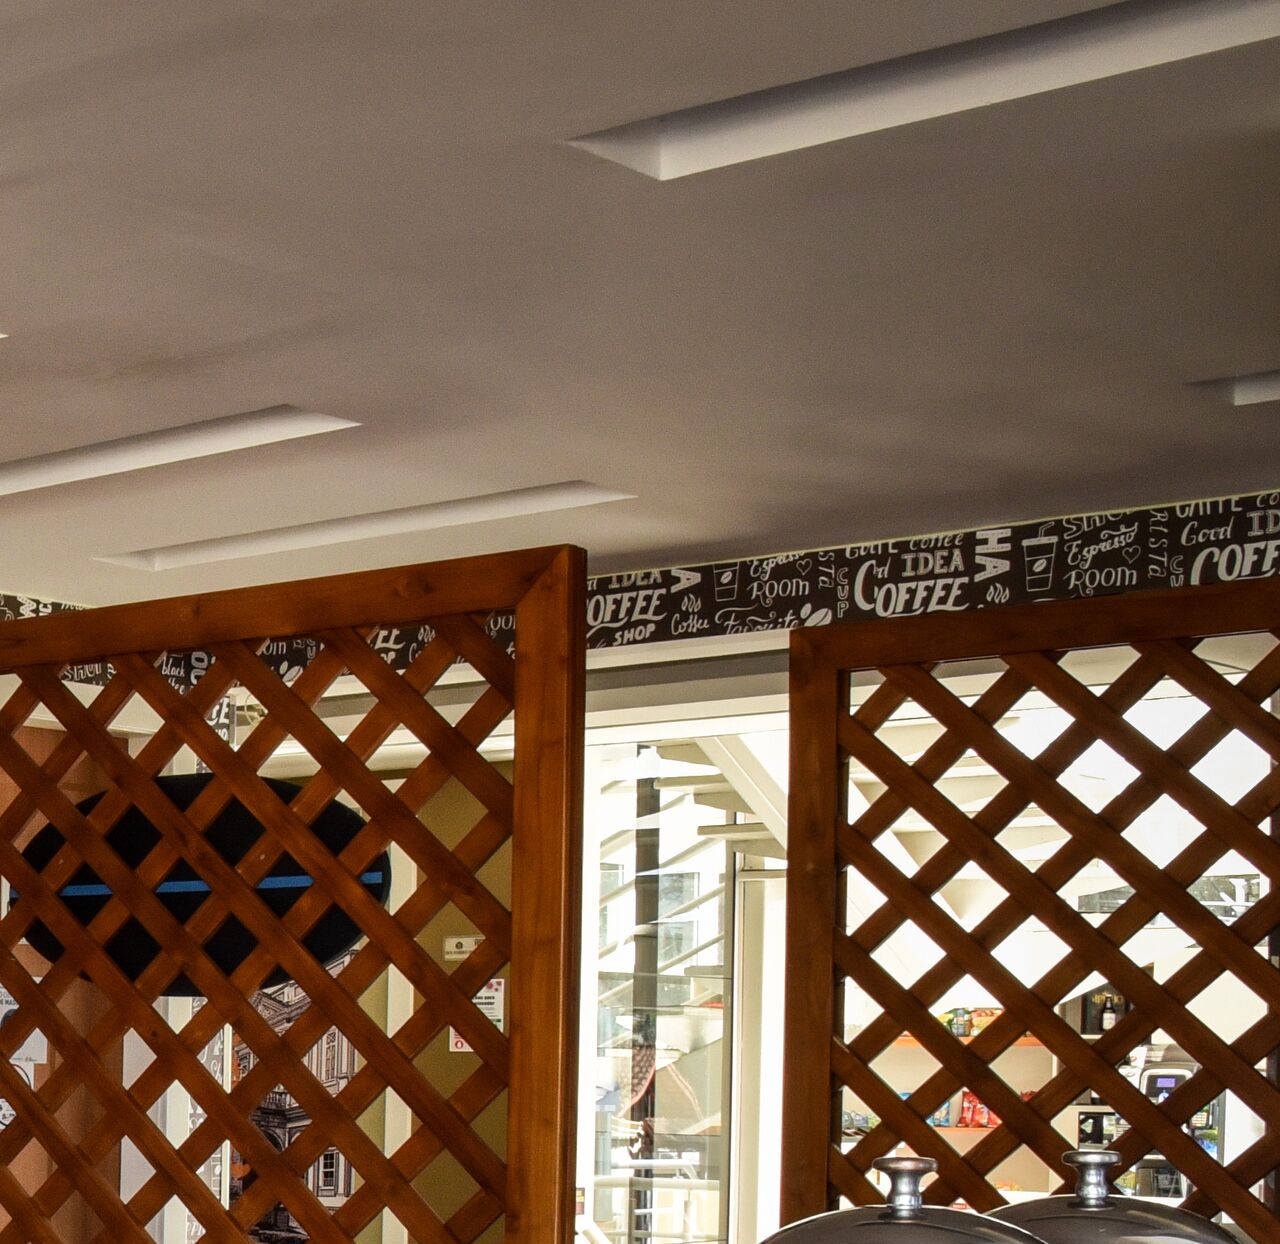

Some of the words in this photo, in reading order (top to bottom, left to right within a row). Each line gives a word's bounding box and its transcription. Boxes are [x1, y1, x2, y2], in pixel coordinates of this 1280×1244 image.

[1063, 522, 1139, 568] Espresso
[1181, 516, 1234, 546] Good
[902, 549, 964, 577] IDEA
[836, 567, 849, 618] CUP
[854, 558, 970, 618] COFFEE
[615, 623, 656, 646] SHOP
[671, 614, 709, 635] Coffee
